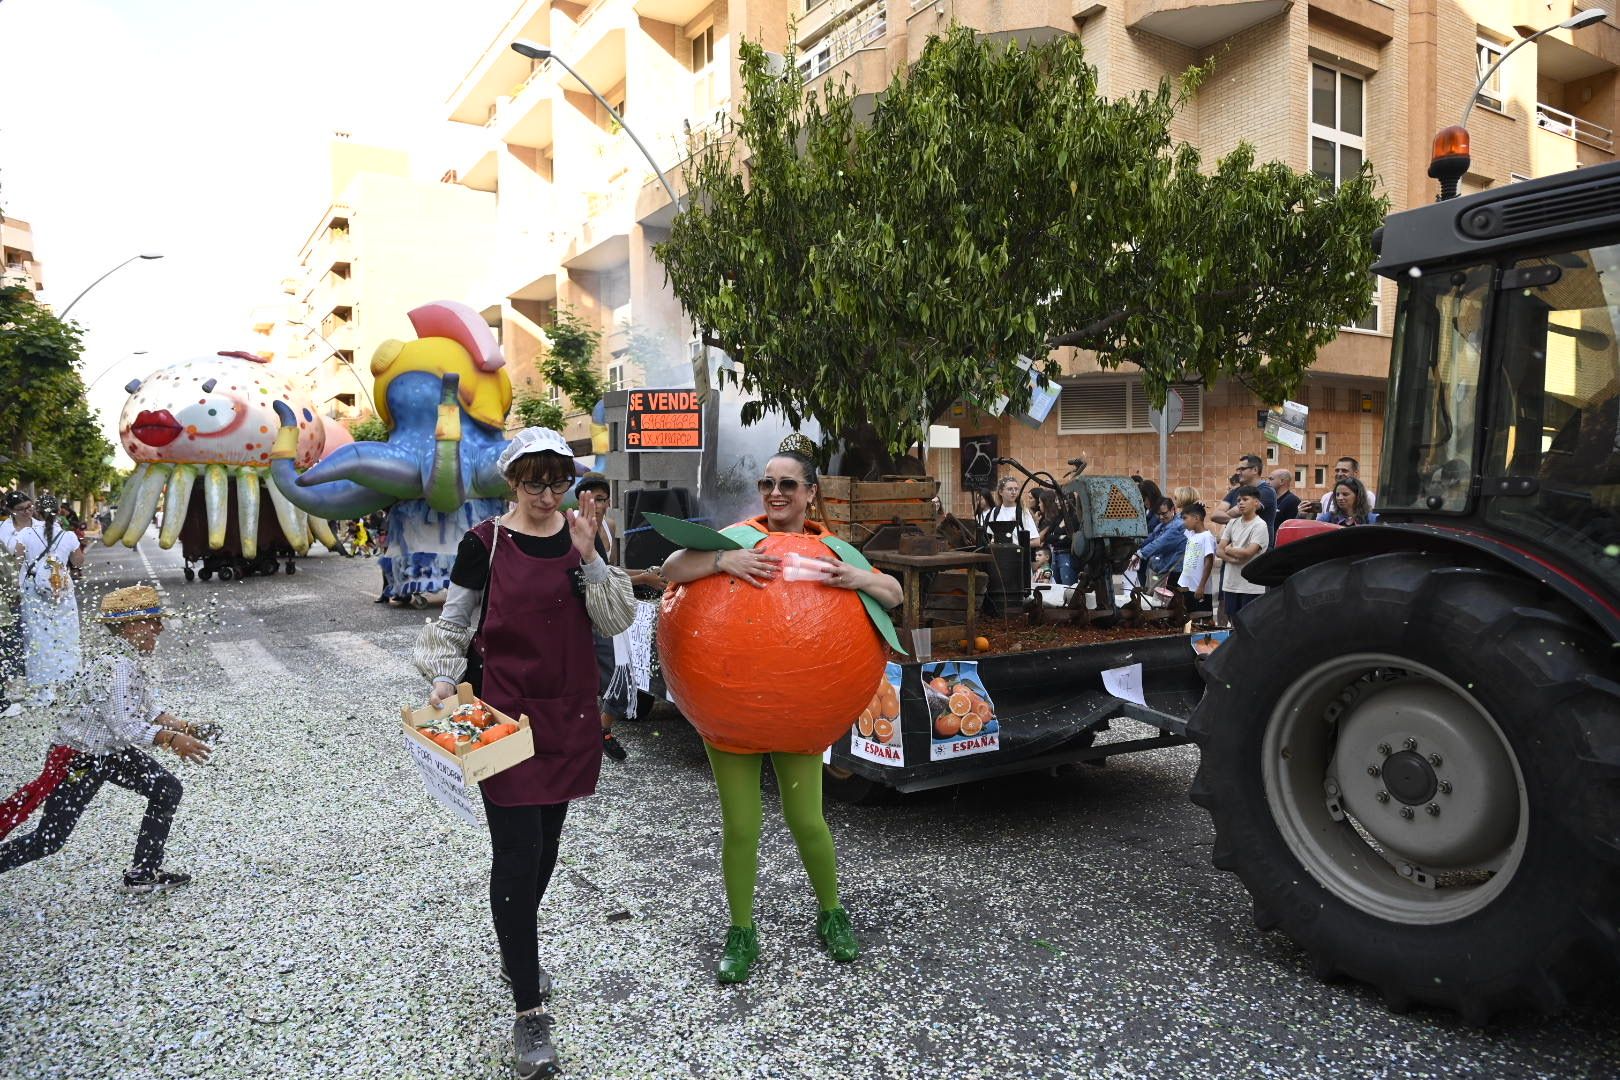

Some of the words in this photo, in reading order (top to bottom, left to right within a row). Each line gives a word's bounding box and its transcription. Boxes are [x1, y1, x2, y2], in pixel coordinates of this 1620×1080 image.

[630, 393, 644, 411] SE
[648, 392, 699, 410] VENDE
[864, 742, 901, 760] ESPAÑA
[952, 734, 996, 753] ESPAÑA
